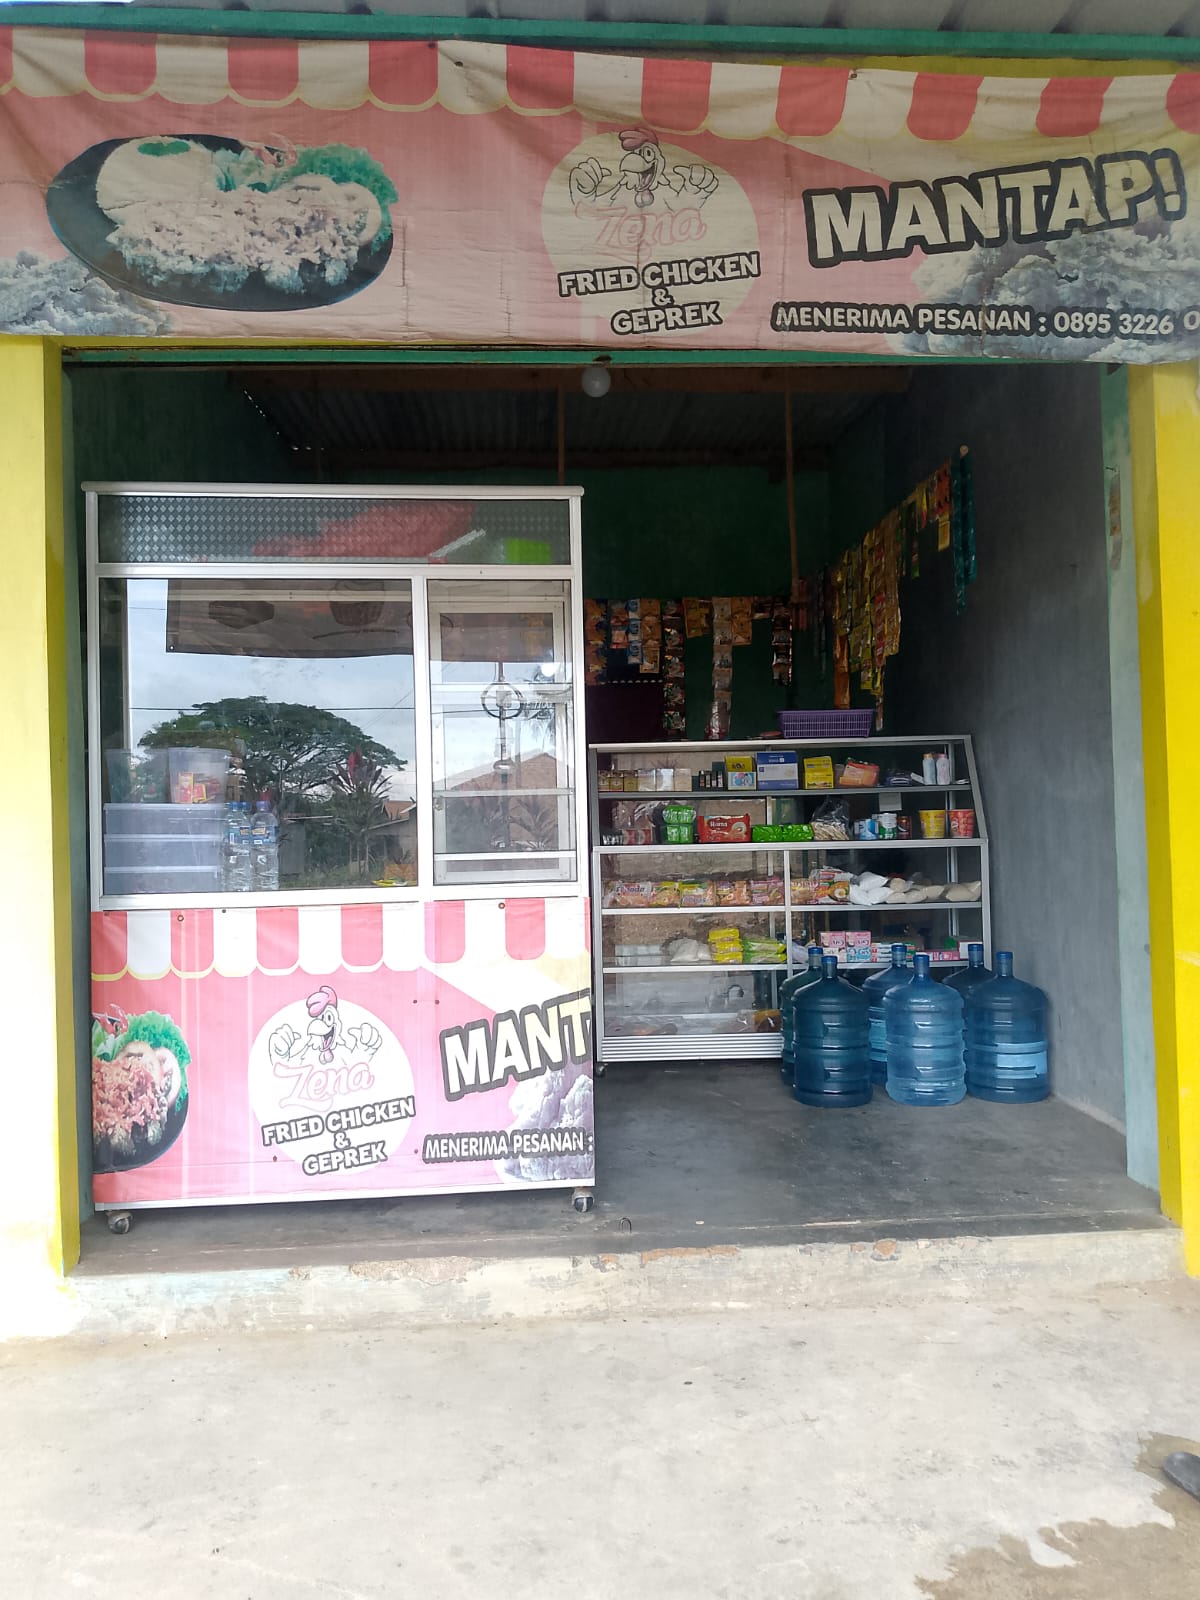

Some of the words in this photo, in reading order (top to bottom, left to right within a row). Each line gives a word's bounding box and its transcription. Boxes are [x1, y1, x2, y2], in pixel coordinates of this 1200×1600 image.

[806, 151, 1185, 265] MANTAP!
[558, 266, 640, 296] FRIED
[642, 251, 760, 286] CHICKEN
[652, 288, 674, 306] &
[611, 302, 722, 334] GEPREK
[775, 305, 910, 330] MENERIMA
[917, 308, 1031, 333] PESANAN
[1053, 310, 1111, 334] 0895
[1118, 312, 1175, 335] 3226
[441, 990, 592, 1099] MANT
[273, 1062, 374, 1112] Zena
[262, 1116, 324, 1146] FRIED
[325, 1096, 415, 1132] CHICKEN
[333, 1132, 350, 1149] &
[424, 1135, 508, 1160] MENERIMA
[513, 1130, 584, 1156] PESANAN
[303, 1141, 387, 1176] GEPREK
